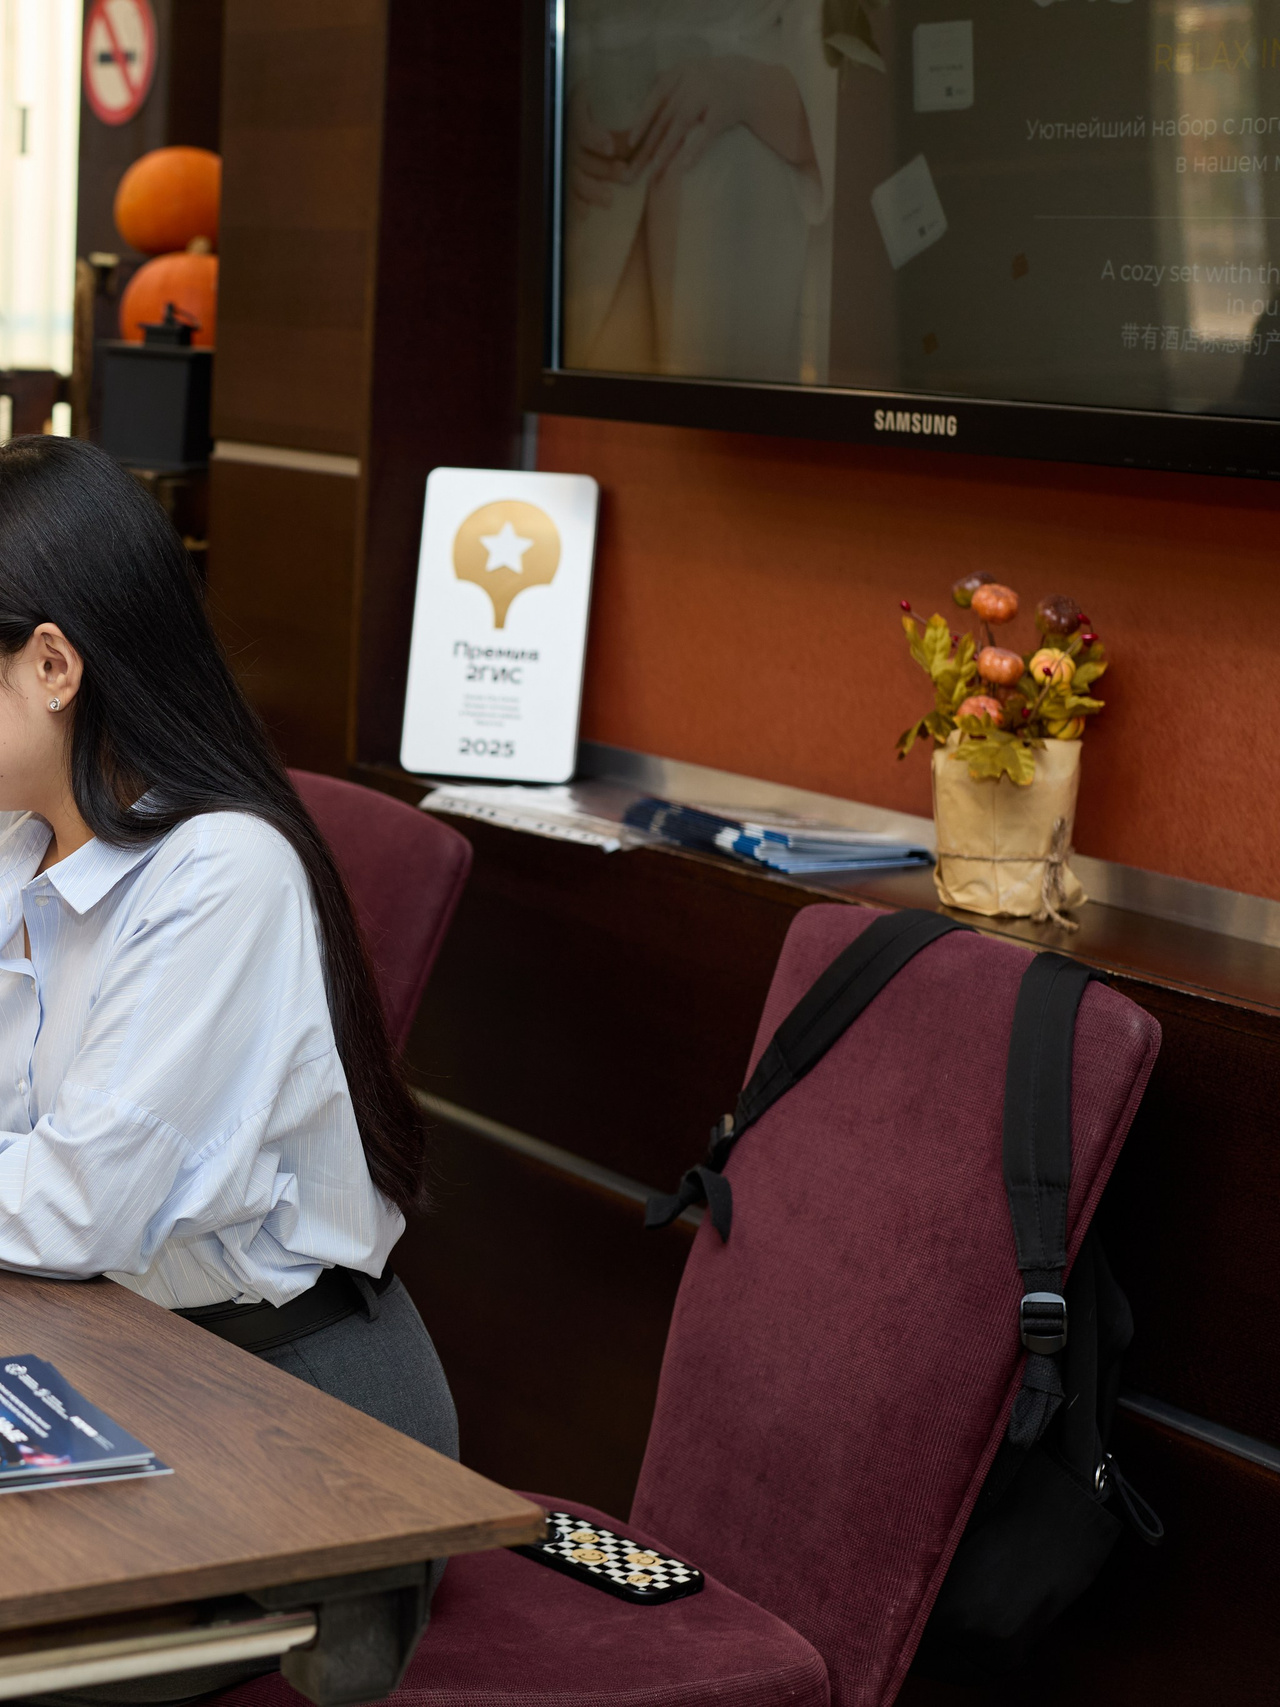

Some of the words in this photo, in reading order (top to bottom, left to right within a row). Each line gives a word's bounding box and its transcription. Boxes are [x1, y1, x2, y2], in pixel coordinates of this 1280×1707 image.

[1154, 40, 1251, 73] RELAX
[1026, 115, 1145, 140] Уютнейший
[1153, 114, 1218, 140] набор
[1223, 118, 1235, 135] с
[1176, 156, 1187, 173] в
[1193, 155, 1268, 173] нашем
[1101, 259, 1116, 280] A
[1120, 264, 1166, 287] cozy
[1170, 263, 1200, 283] set
[1205, 261, 1252, 284] with
[1227, 293, 1245, 314] in
[874, 409, 958, 437] SAMSUNG
[453, 640, 540, 661] Премия
[466, 664, 523, 685] 2ГИС
[459, 737, 516, 758] 2025
